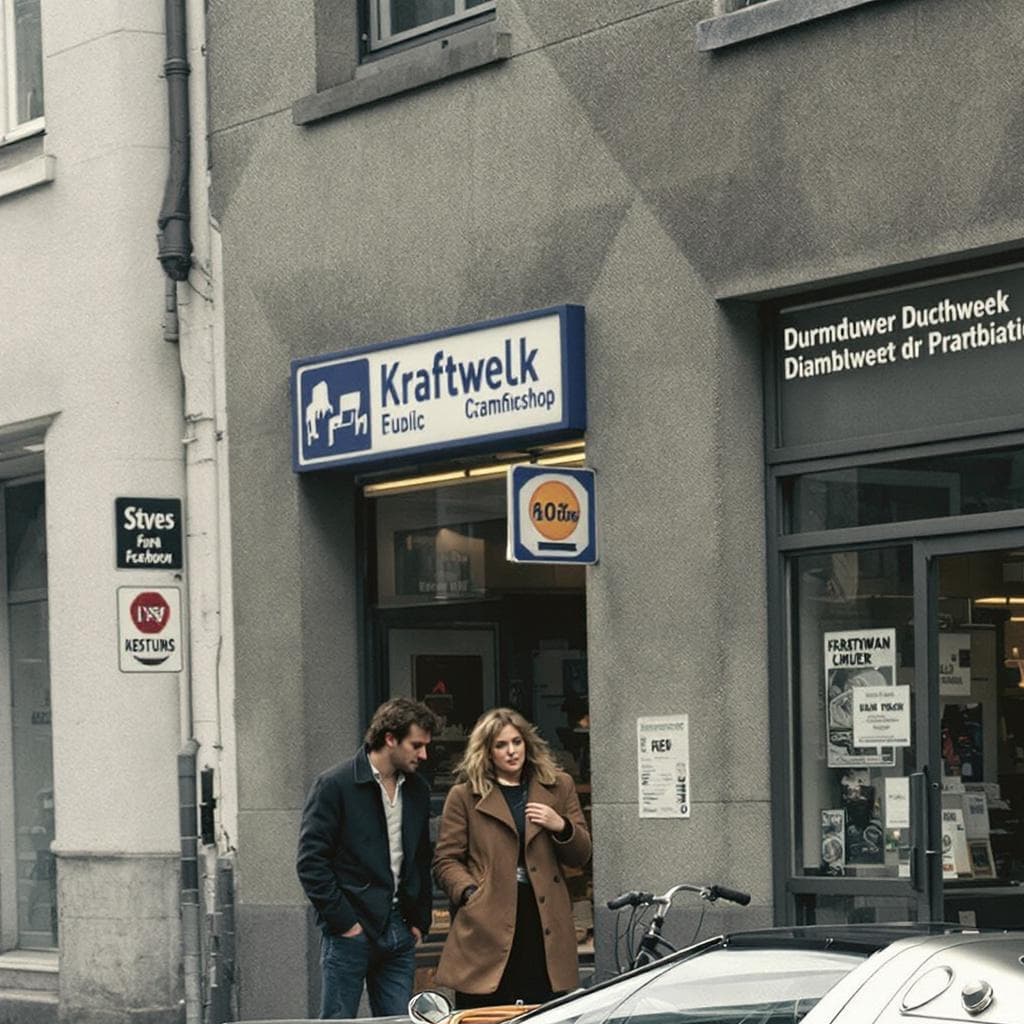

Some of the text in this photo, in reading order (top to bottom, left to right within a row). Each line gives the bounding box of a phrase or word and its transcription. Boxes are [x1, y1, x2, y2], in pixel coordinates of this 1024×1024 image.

[784, 289, 1010, 350] Durmduwer Ducthweek
[380, 336, 539, 408] Kraftwelk
[784, 343, 897, 380] Diamblweet
[901, 335, 923, 361] dr
